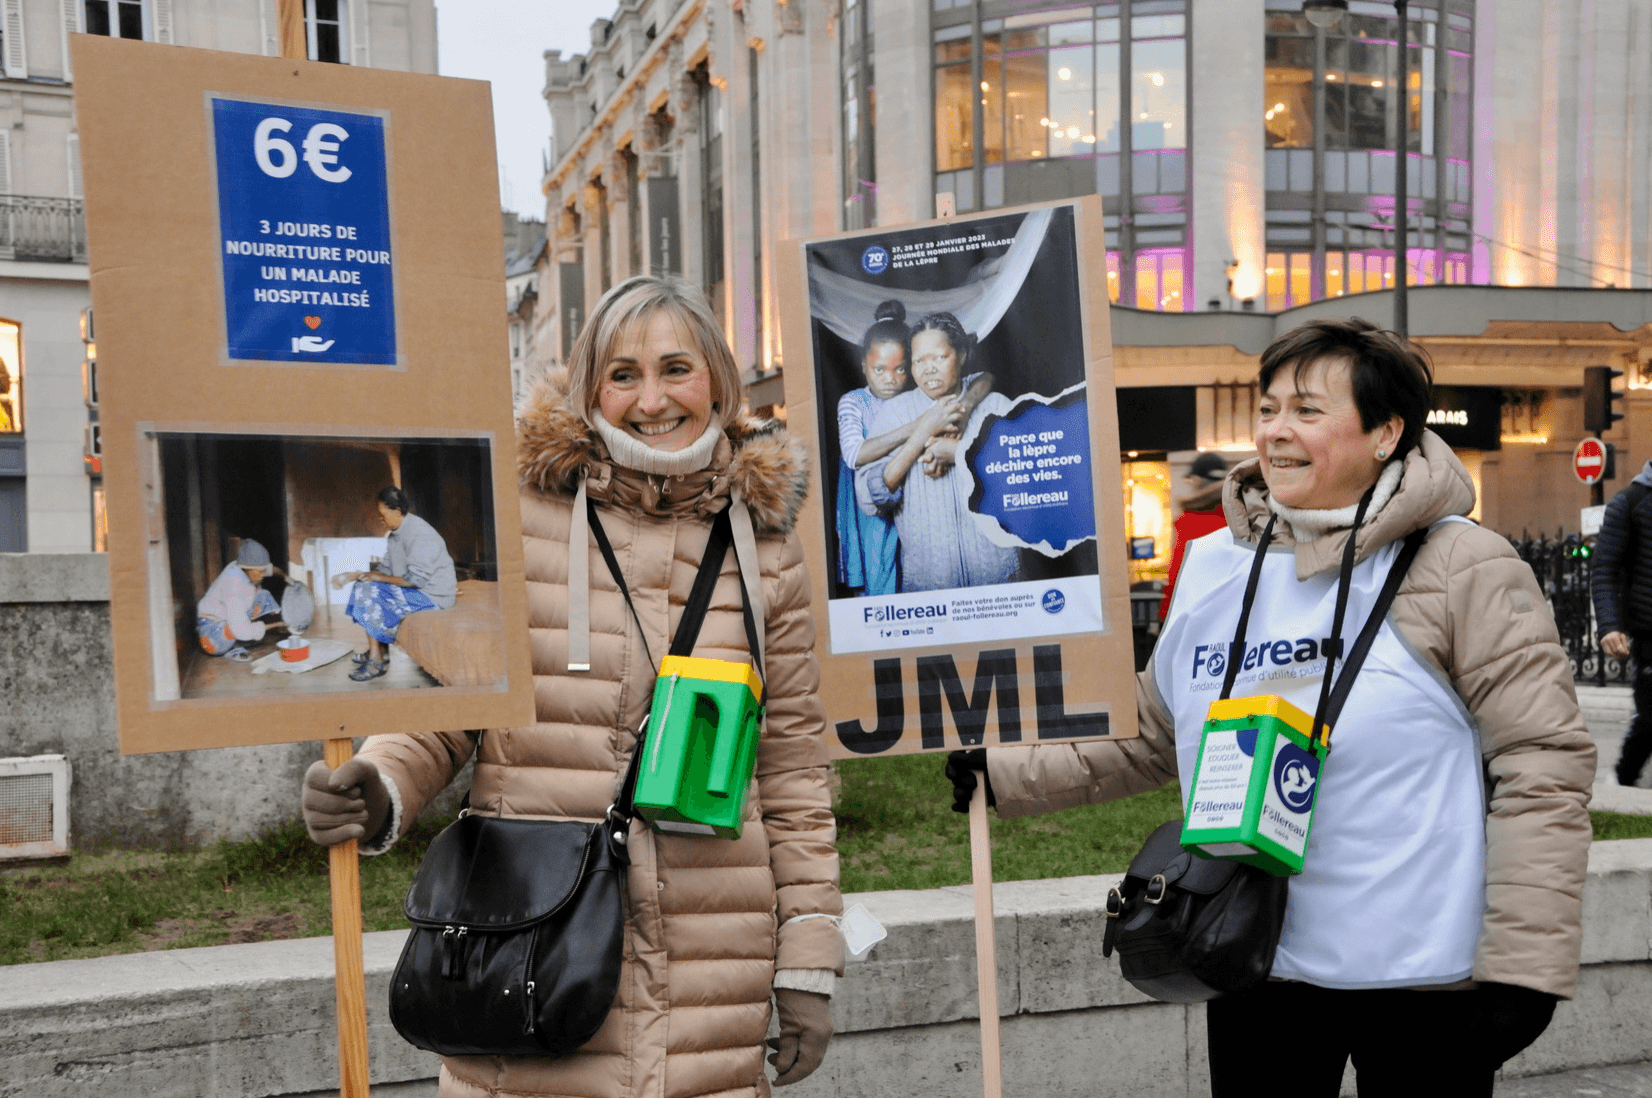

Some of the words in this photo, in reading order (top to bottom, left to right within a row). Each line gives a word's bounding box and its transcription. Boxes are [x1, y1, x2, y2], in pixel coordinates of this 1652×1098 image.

[253, 117, 353, 183] 6€
[259, 219, 271, 234] 3
[275, 221, 332, 238] JOURS
[336, 225, 358, 240] DE
[892, 249, 926, 261] JOURNÉE
[926, 245, 965, 256] MONDIALE
[965, 242, 980, 252] DES
[981, 237, 1016, 249] MALADES
[914, 243, 924, 251] ET
[935, 236, 967, 247] JANVIER
[967, 234, 986, 243] 2023
[225, 240, 342, 261] NOURRITURE
[345, 248, 391, 265] POUR
[892, 261, 903, 269] DE
[260, 265, 287, 280] UN
[291, 267, 361, 285] MALADE
[253, 288, 371, 308] HOSPITALISÉ
[1425, 409, 1469, 426] ARAIS
[999, 433, 1037, 447] Parce
[1038, 430, 1064, 443] que
[1008, 446, 1021, 459] la
[1023, 444, 1057, 457] lèpre
[985, 458, 1035, 474] déchire
[1036, 454, 1082, 468] encore
[1006, 473, 1030, 485] des
[1032, 469, 1063, 482] vies.
[1002, 491, 1069, 507] Follereau
[951, 598, 973, 607] Faites
[974, 597, 993, 605] votre
[1009, 593, 1034, 603] auprès
[976, 603, 1013, 612] bénévoles
[863, 604, 947, 623] Follereau
[952, 610, 1018, 621] raoul-follereau.org
[835, 644, 1110, 754] JML
[1193, 801, 1244, 813] Follereau
[1262, 804, 1306, 838] Follereau
